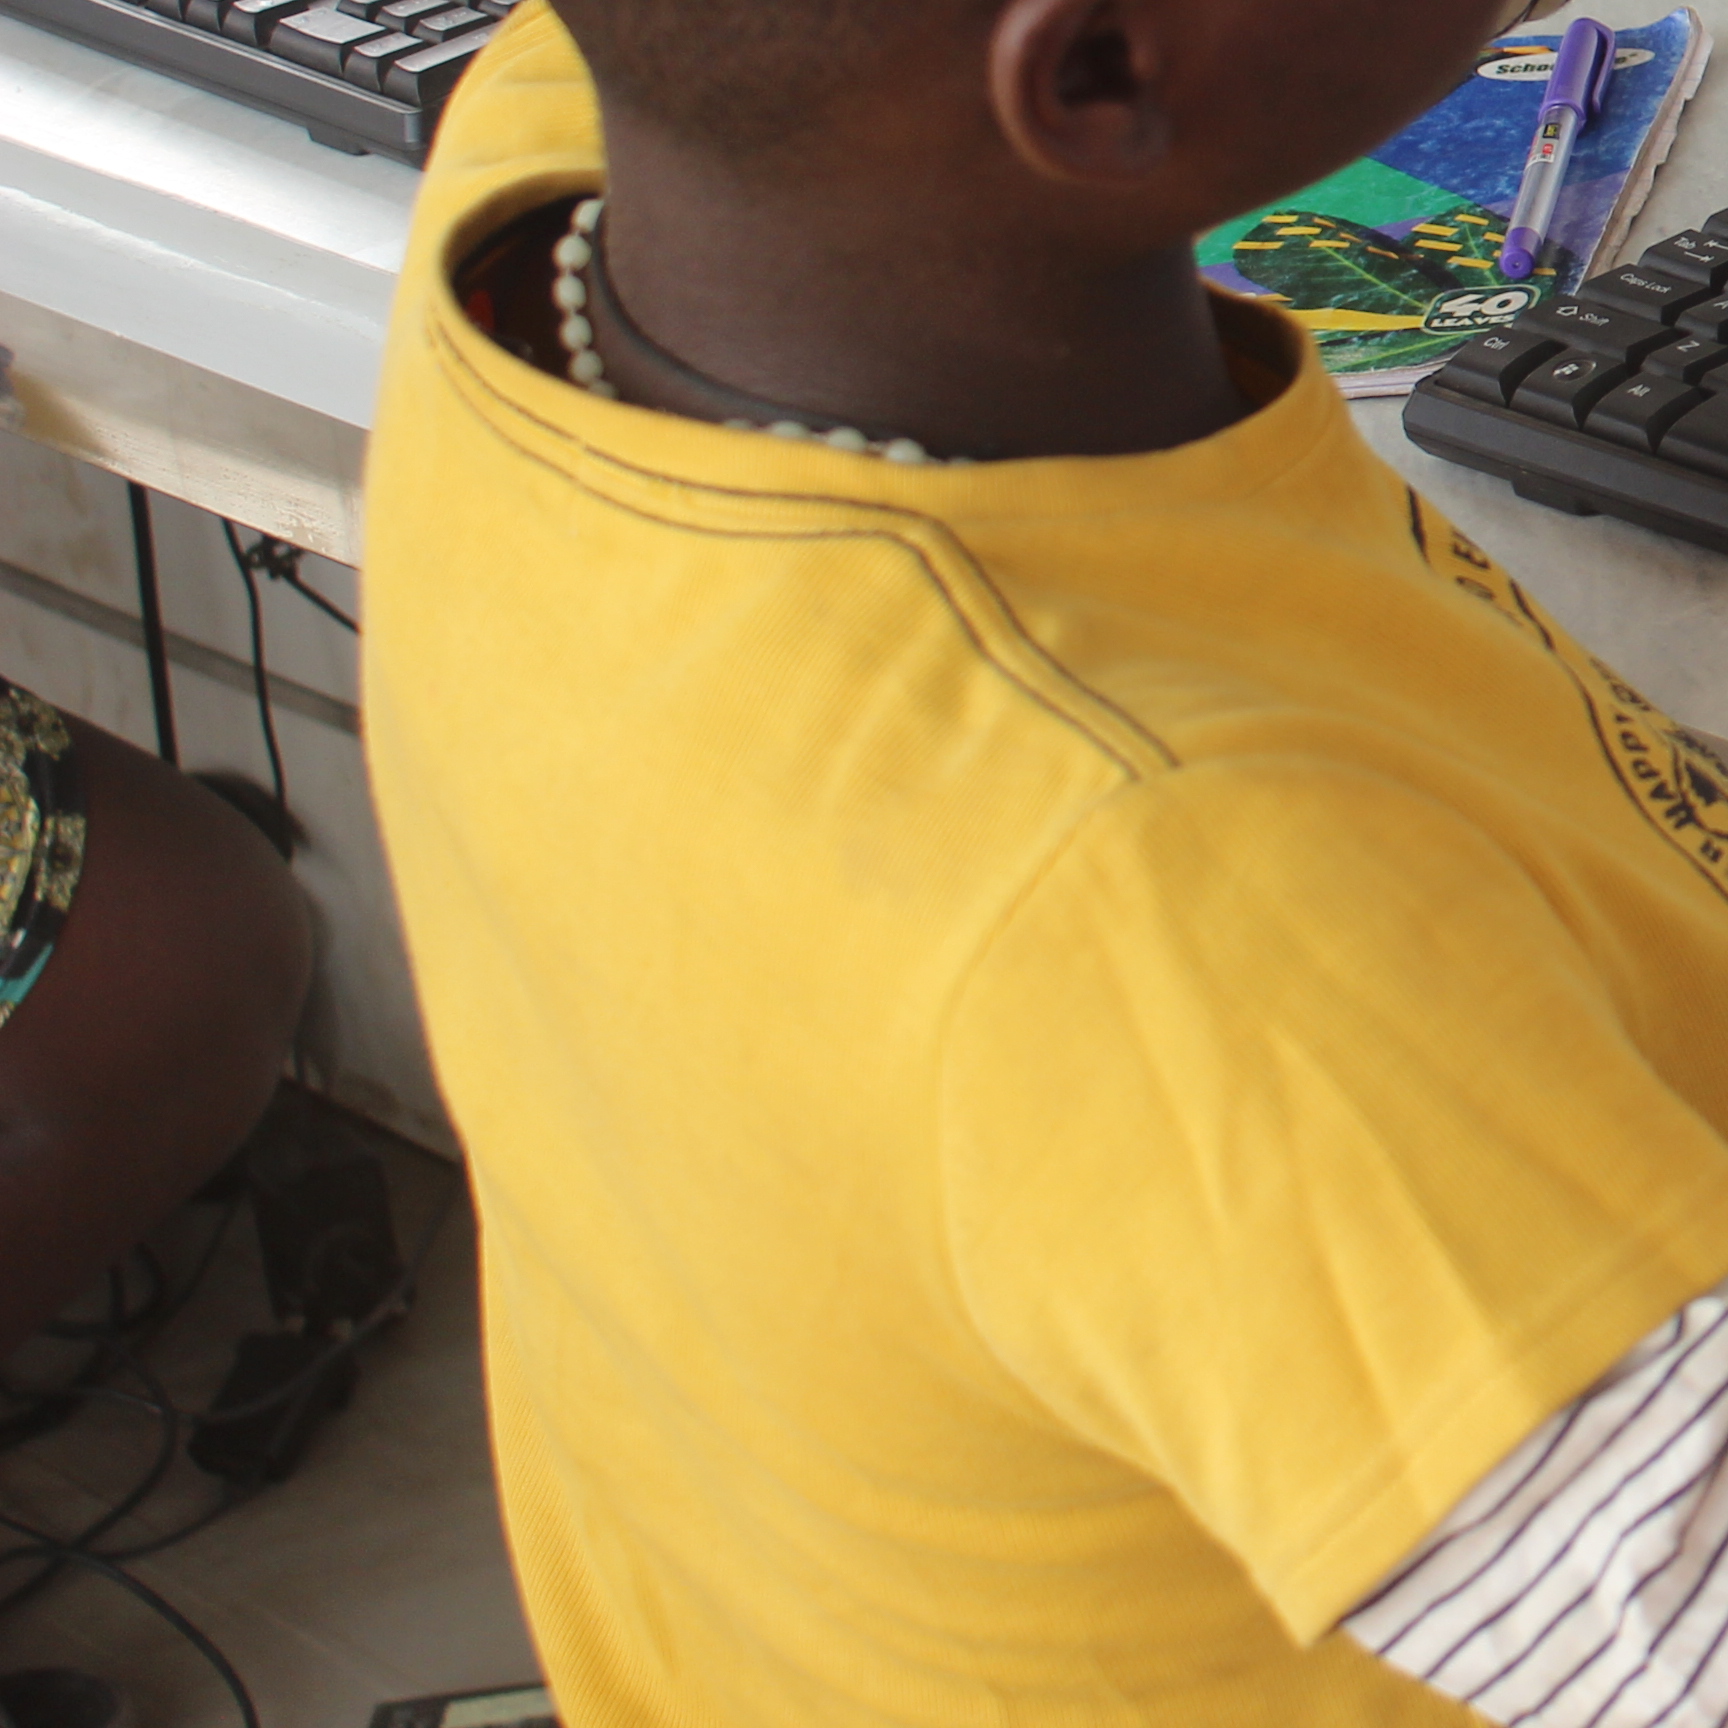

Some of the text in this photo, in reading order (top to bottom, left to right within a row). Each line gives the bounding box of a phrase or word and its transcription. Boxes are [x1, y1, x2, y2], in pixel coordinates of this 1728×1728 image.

[1673, 236, 1696, 250] Tab
[1620, 273, 1671, 294] Caps Lock
[1440, 290, 1529, 317] 40
[1429, 313, 1515, 328] LEAVES
[1579, 312, 1610, 327] Shift
[1483, 336, 1511, 351] Ctrl
[1677, 340, 1700, 353] Z
[1627, 383, 1651, 398] Alt
